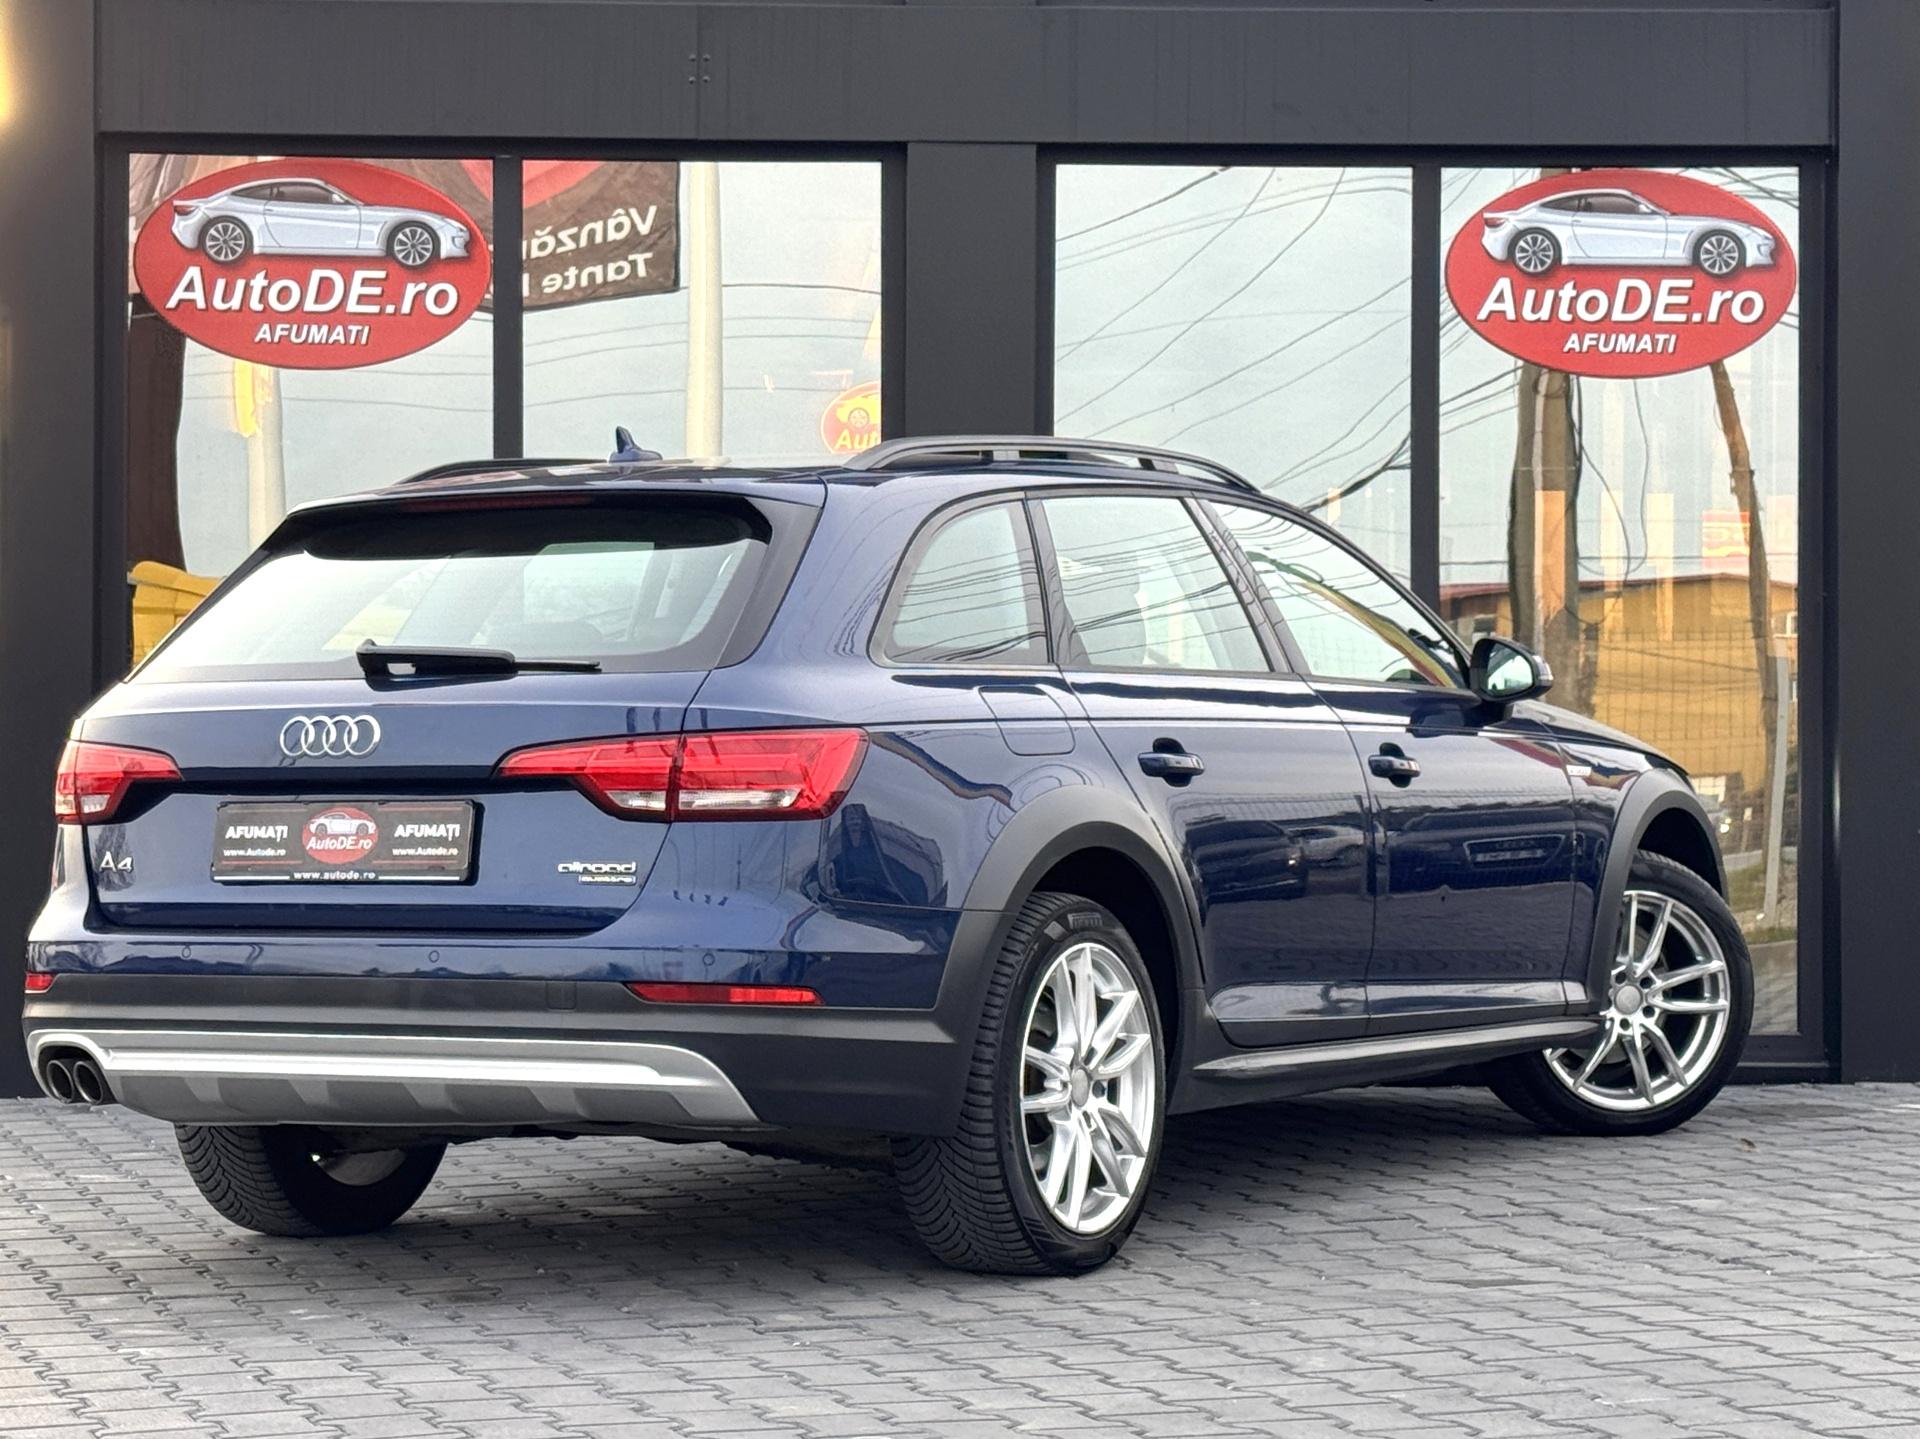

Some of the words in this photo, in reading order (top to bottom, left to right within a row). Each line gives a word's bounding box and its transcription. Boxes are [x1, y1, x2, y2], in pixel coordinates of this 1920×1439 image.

[165, 266, 458, 316] AutoDE.ro
[1476, 277, 1765, 323] AutoDE.ro
[254, 323, 370, 345] AFUMATI
[1563, 333, 1677, 353] AFUMATI
[306, 836, 373, 851] AutoDE.ro
[100, 850, 133, 872] A4
[293, 870, 376, 880] www.autode.ro
